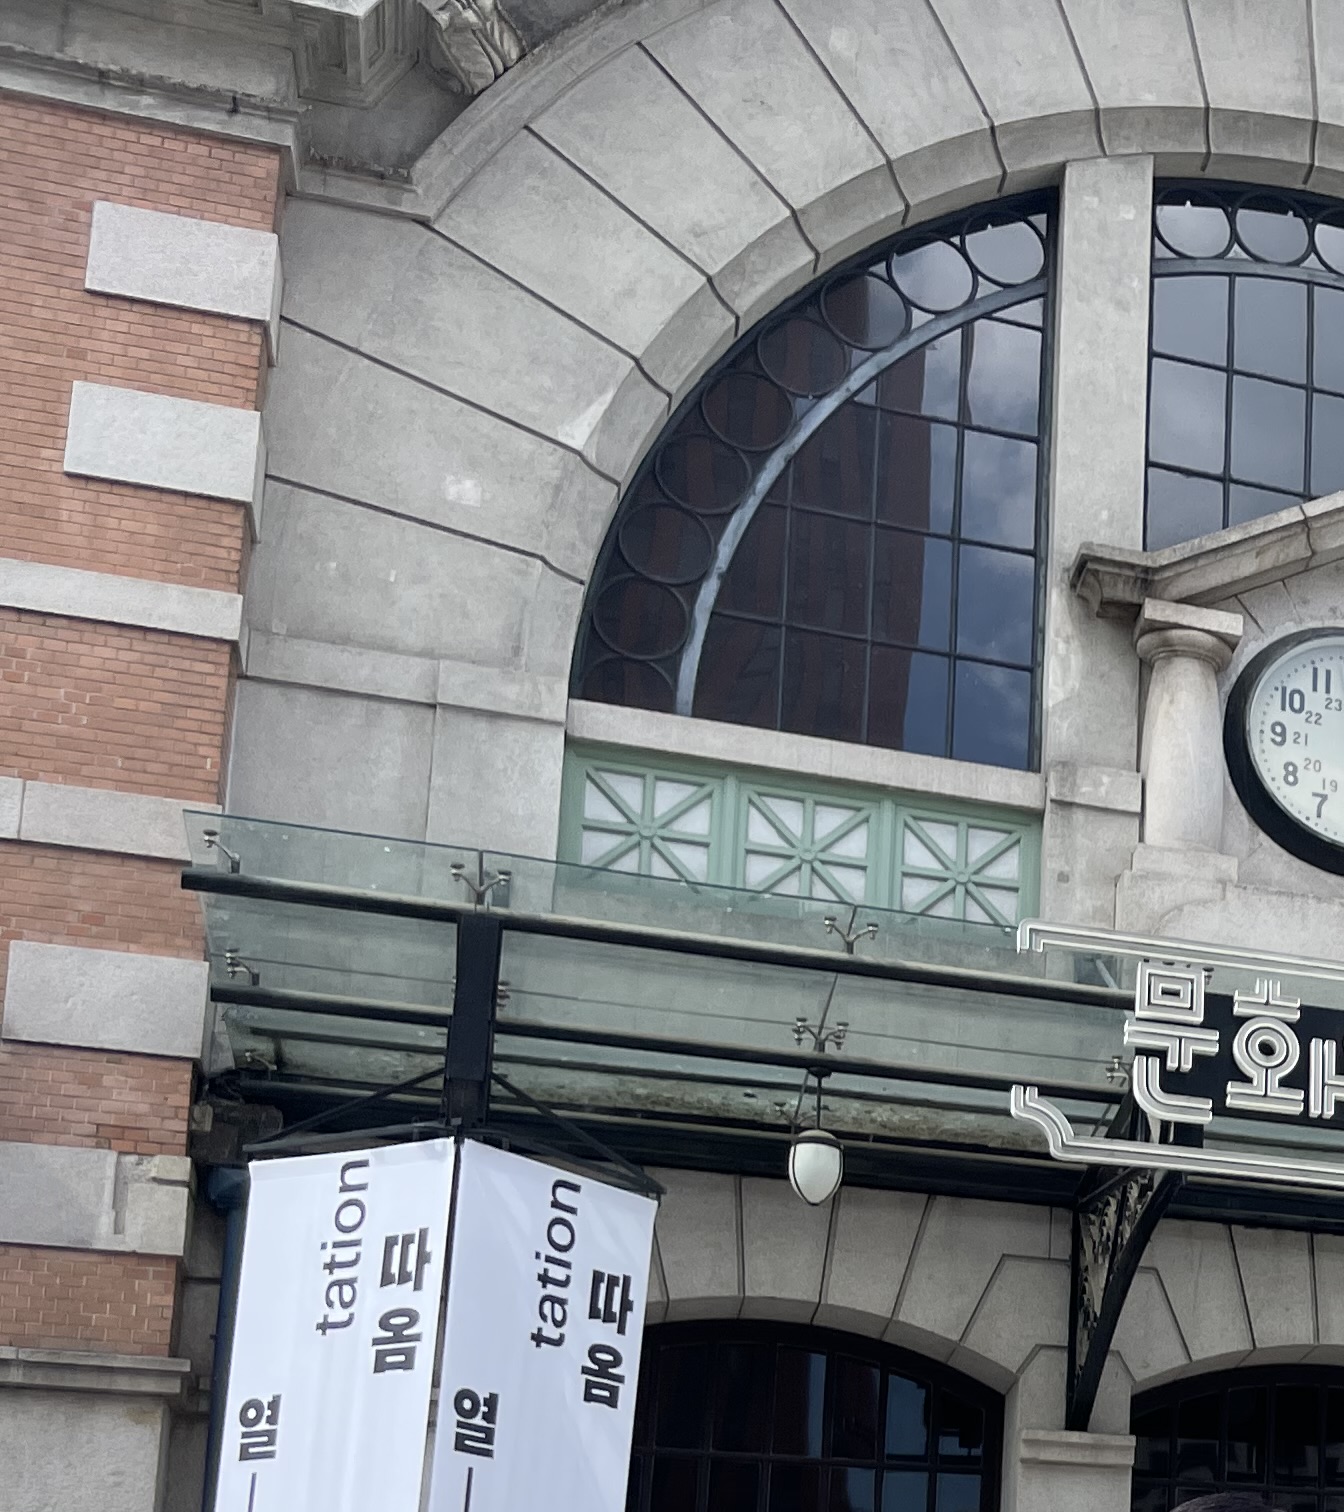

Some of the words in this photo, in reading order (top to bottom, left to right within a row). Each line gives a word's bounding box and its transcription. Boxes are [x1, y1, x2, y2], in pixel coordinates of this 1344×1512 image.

[1312, 666, 1331, 694] 11
[1280, 686, 1305, 713] 10
[1325, 698, 1342, 711] 23
[1304, 711, 1322, 725] 22
[1270, 721, 1287, 746] 9
[1283, 761, 1299, 786] 8
[1312, 792, 1328, 818] 7
[316, 1158, 370, 1336] tation
[531, 1178, 582, 1348] tation
